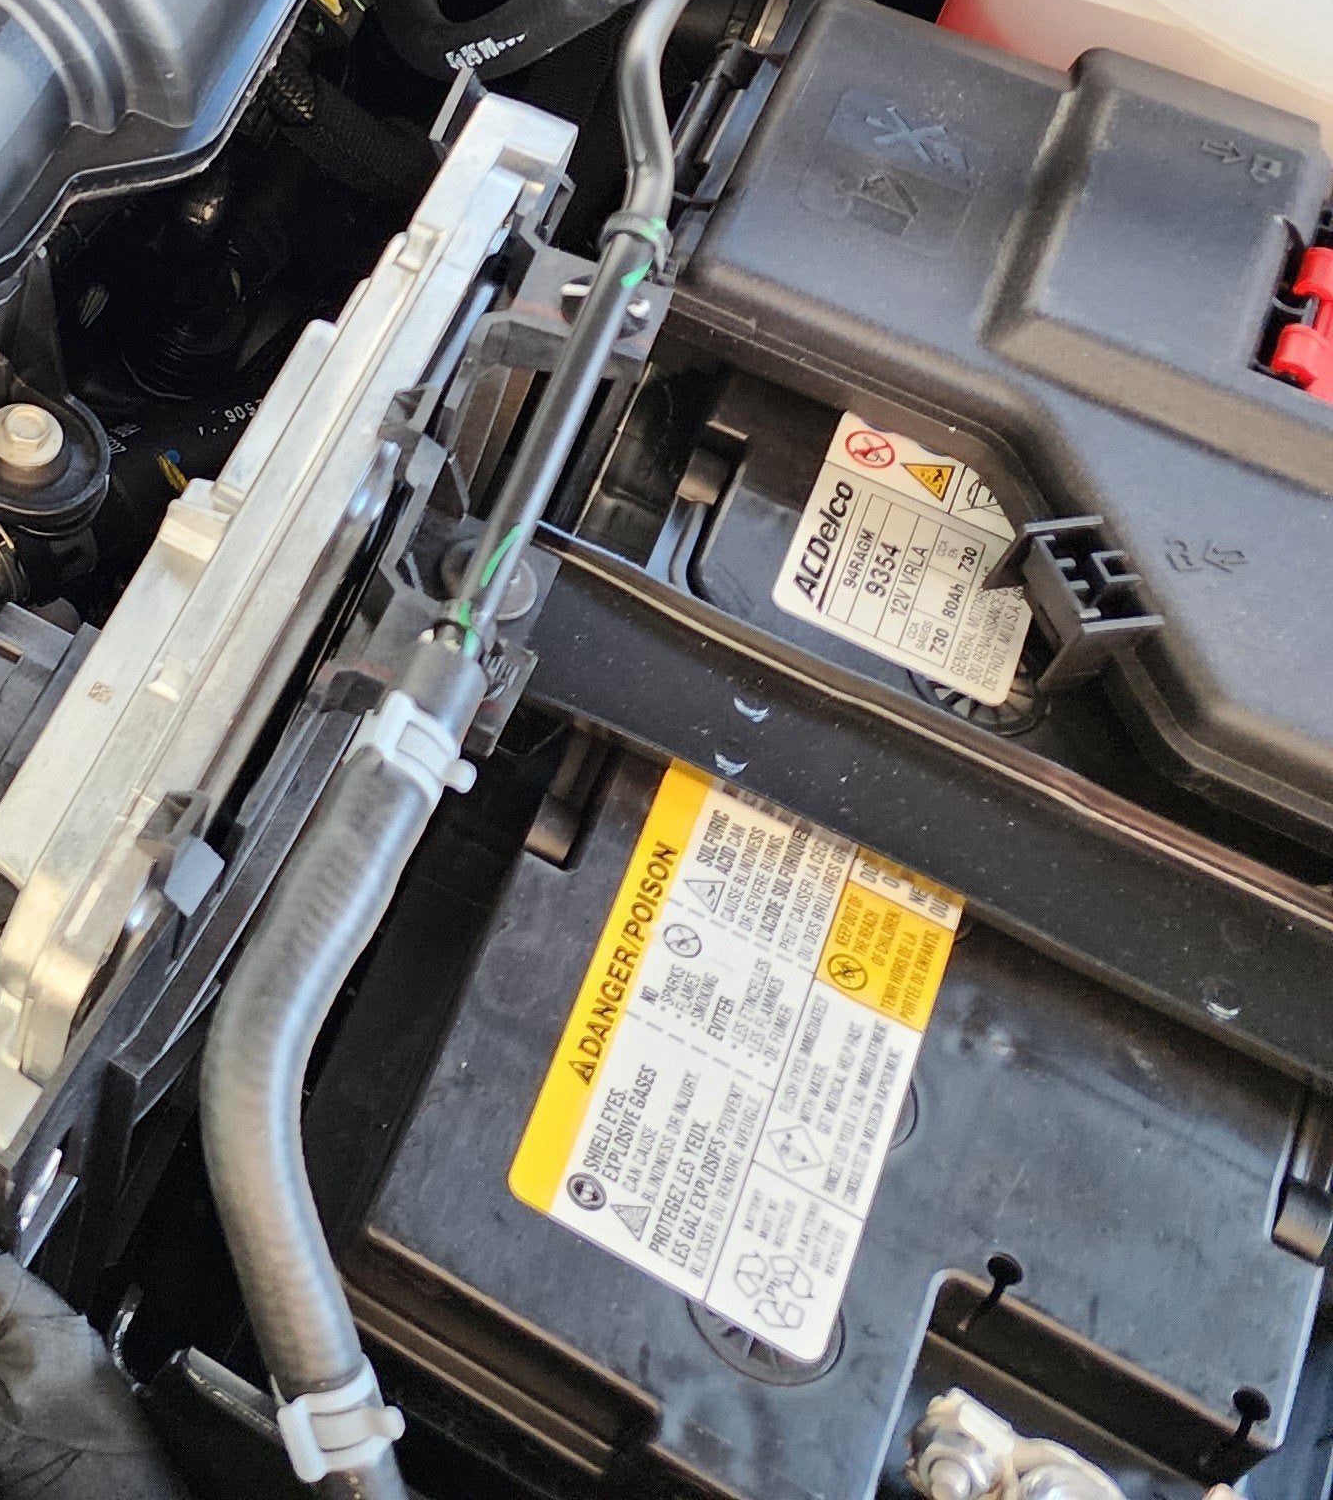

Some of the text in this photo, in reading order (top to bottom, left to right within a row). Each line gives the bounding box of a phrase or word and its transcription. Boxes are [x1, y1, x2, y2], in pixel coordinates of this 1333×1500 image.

[792, 480, 854, 604] ACDelco
[843, 528, 875, 588] 94RAGM
[958, 546, 977, 573] 730
[866, 542, 901, 597] 9354
[890, 545, 929, 616] 12V VRLA
[942, 583, 965, 618] 80Ah
[929, 628, 949, 655] 730
[950, 630, 977, 676] GENERAL
[966, 663, 984, 684] 300
[696, 810, 729, 866] SULFURIC
[715, 823, 746, 875] ACID CAN
[720, 827, 765, 922] CAUSE BLINDNESS
[738, 834, 785, 931] OR SEVERE BURNS.
[772, 829, 809, 899] SULFURIQUE
[778, 922, 798, 952] PEUT
[789, 879, 813, 923] CAUSER
[805, 863, 821, 880] LA
[835, 893, 862, 947] KEEP OUT OF
[580, 843, 676, 1057] DANGER/POISON
[803, 921, 822, 945] DES
[852, 909, 879, 955] THE REACH
[897, 943, 913, 959] DE
[901, 929, 918, 946] LA
[871, 952, 885, 967] OF
[890, 957, 909, 985] HORS
[910, 971, 926, 986] DE
[640, 986, 659, 1005] NO
[660, 965, 685, 1005] SPARKS
[675, 972, 700, 1011] FLAMES
[691, 974, 718, 1021] SMOKING
[731, 1020, 749, 1044] LES
[747, 977, 784, 1053] LES FLAMMES
[764, 1005, 791, 1061] DE FUMER
[789, 1056, 808, 1081] EYES
[838, 1045, 854, 1072] HELP
[583, 1085, 627, 1172] SHIELD EYES.
[602, 1065, 656, 1182] EXPLOSIVE GASES
[622, 1126, 658, 1193] CAN CAUSE
[642, 1136, 676, 1203] BLINDNESS
[666, 1115, 682, 1135] OR
[670, 1083, 742, 1268] LES GAZ EXPLOSIFS PEUVENT
[675, 1158, 695, 1185] LES
